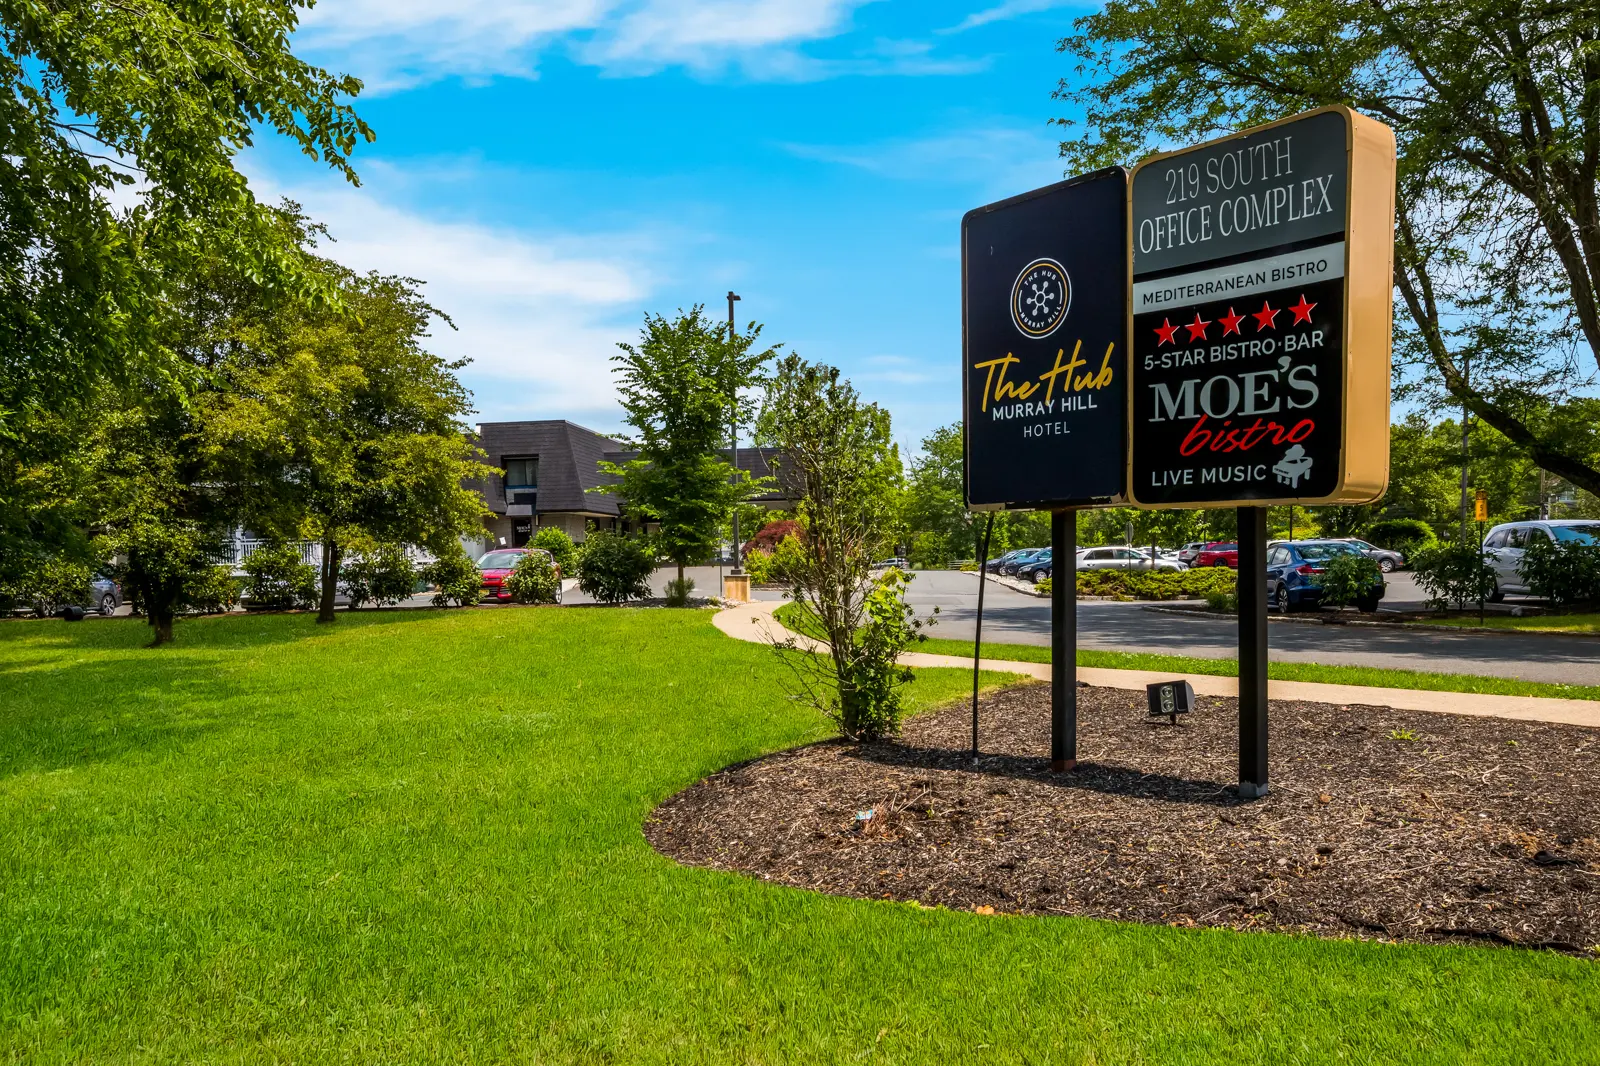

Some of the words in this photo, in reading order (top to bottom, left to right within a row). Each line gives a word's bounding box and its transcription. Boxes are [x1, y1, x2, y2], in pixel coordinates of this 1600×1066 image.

[1165, 163, 1199, 205] 219
[1206, 136, 1293, 194] SOUTH
[1139, 204, 1212, 254] OFFICE
[1219, 174, 1333, 237] COMPLEX
[1024, 272, 1038, 286] THE
[1042, 270, 1056, 280] HUB
[1143, 271, 1266, 305] MEDITERRANEAN
[1272, 259, 1327, 282] BISTRO
[1020, 312, 1044, 328] MURRAY
[1048, 306, 1062, 323] HILL
[1144, 348, 1205, 370] 5-STAR
[974, 352, 1040, 413] The
[1039, 339, 1115, 407] Hub
[992, 400, 1055, 421] MURRAY
[1061, 394, 1097, 412] HILL
[1023, 421, 1070, 438] HOTEL
[1179, 414, 1315, 456] bistro
[1152, 469, 1193, 486] LIVE
[1201, 465, 1267, 483] MUSIC
